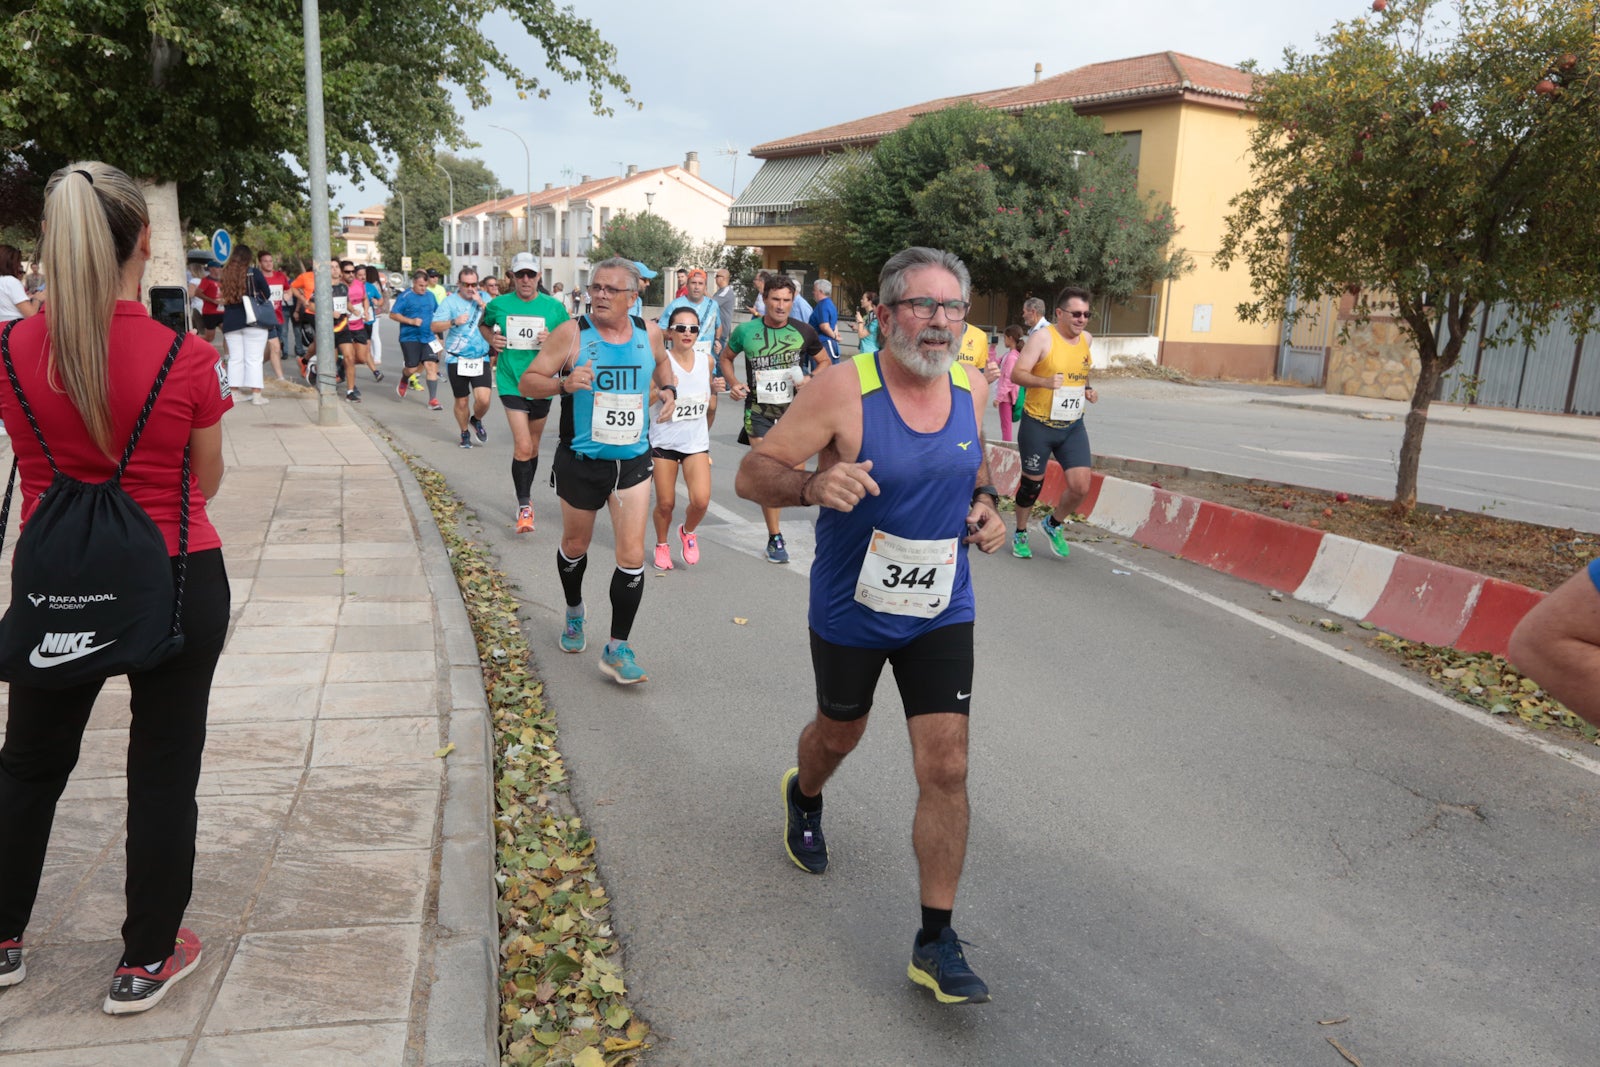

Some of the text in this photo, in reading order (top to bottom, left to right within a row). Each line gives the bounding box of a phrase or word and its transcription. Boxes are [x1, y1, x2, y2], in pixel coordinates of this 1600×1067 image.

[518, 328, 533, 339] 40
[464, 362, 479, 370] 147
[765, 381, 787, 393] 410
[1061, 398, 1081, 409] 476
[676, 403, 705, 418] 2219
[605, 410, 636, 426] 539
[882, 564, 937, 589] 344
[48, 594, 117, 604] RAFA NADAL
[40, 631, 96, 654] NIKE
